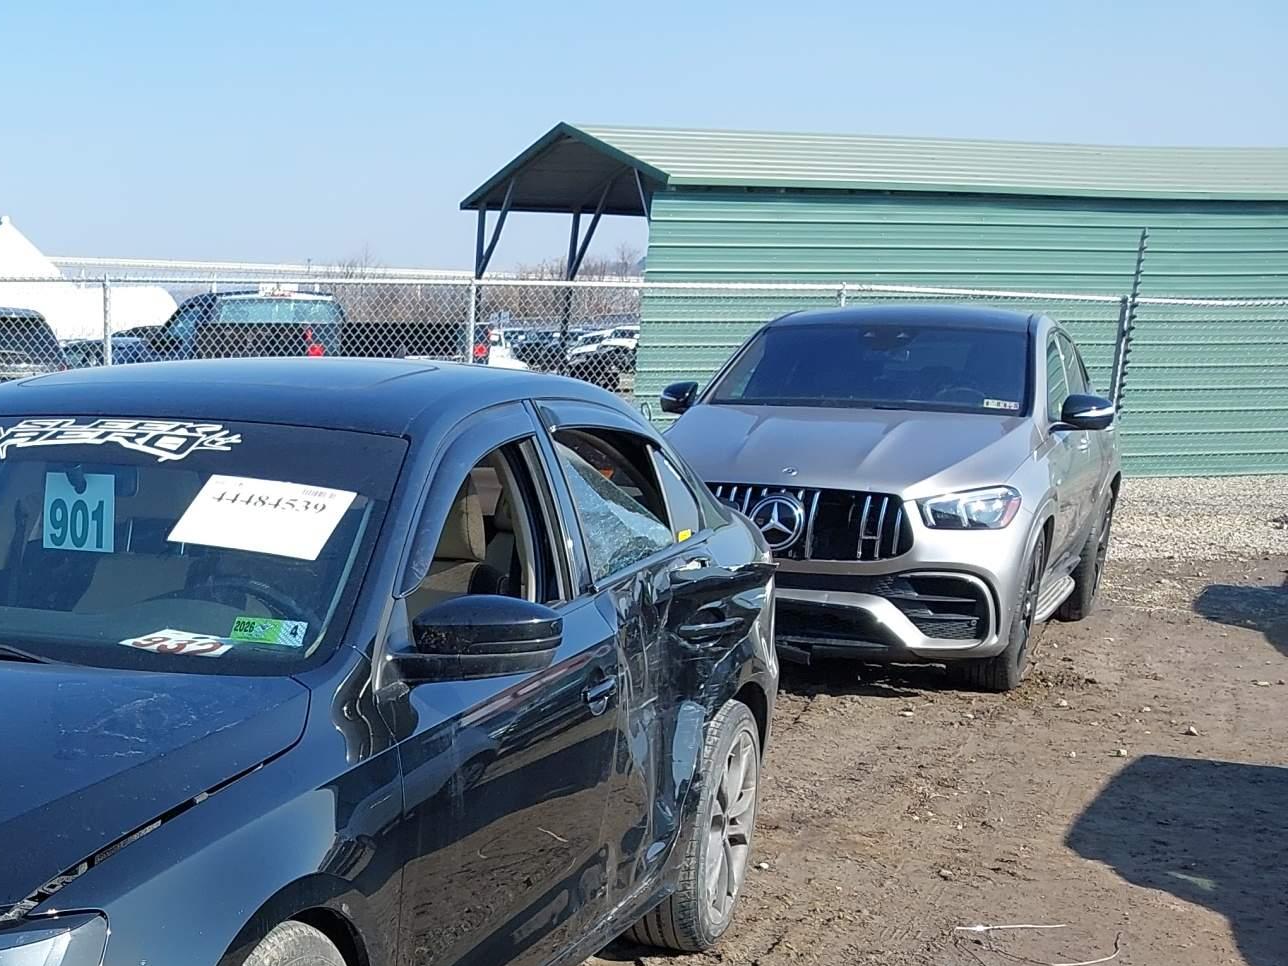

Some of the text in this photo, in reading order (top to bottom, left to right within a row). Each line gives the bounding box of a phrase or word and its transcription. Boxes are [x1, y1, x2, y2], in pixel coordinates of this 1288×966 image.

[212, 491, 327, 513] 44484539
[49, 498, 105, 549] 901
[233, 620, 256, 634] 2026
[289, 624, 299, 639] 4
